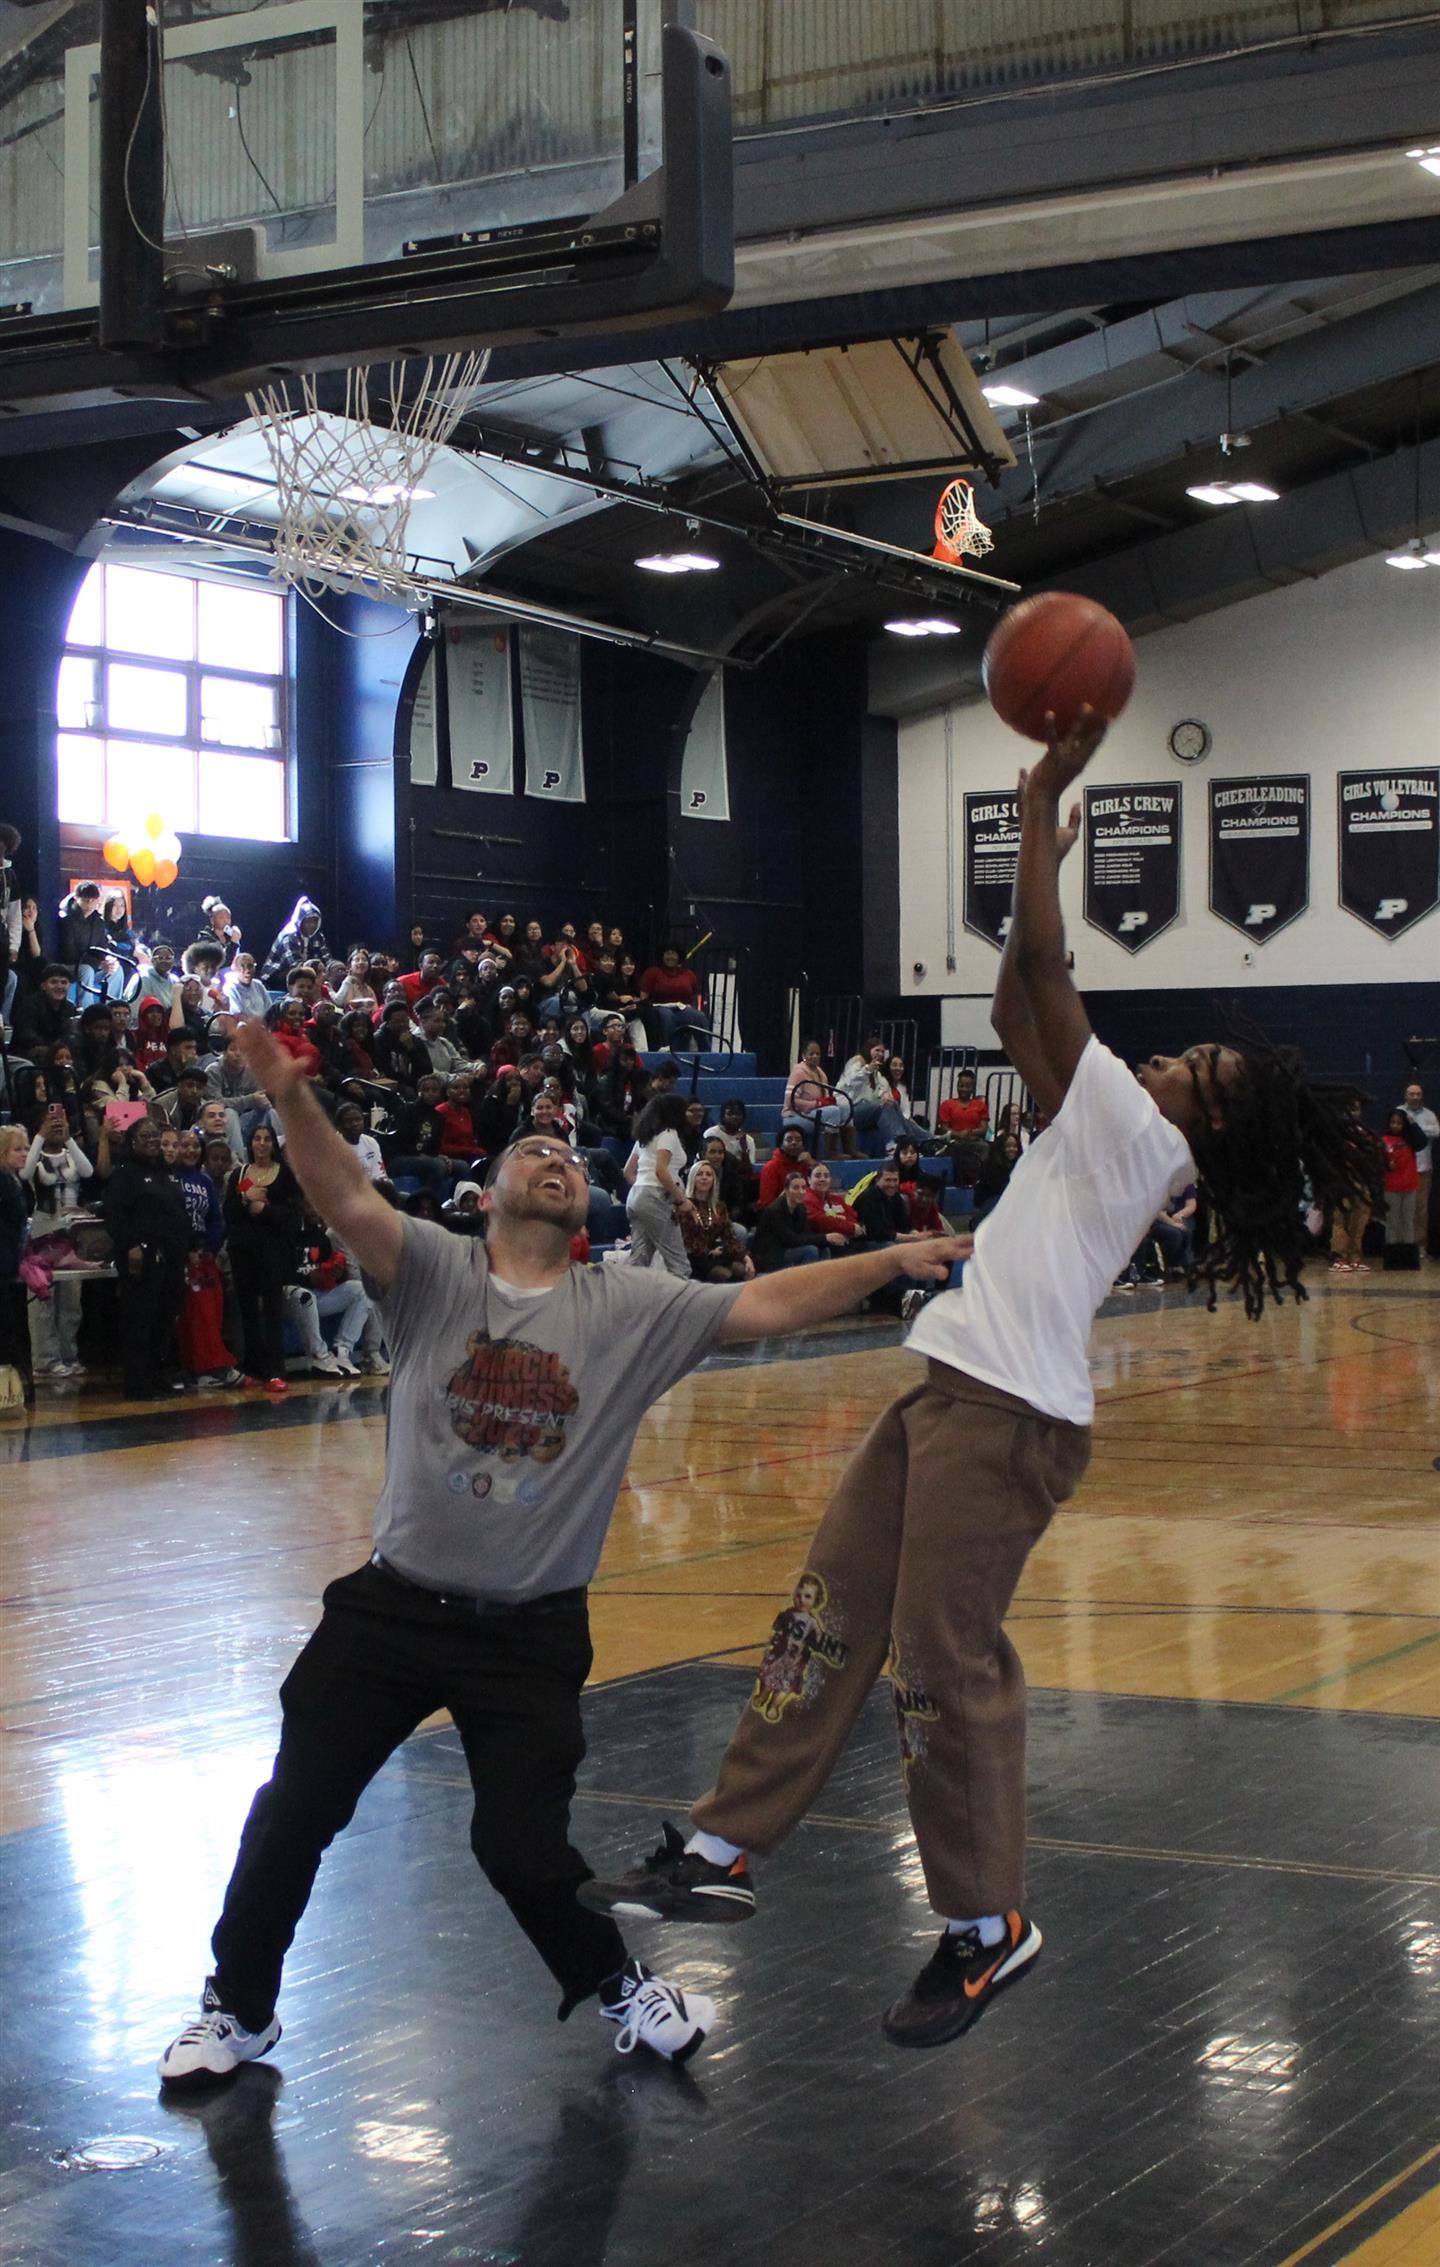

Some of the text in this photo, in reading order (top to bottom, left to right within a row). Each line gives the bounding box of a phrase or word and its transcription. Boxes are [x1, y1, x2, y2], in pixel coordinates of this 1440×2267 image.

[470, 761, 488, 779] P
[543, 771, 560, 788] P
[690, 791, 706, 808] P
[1215, 787, 1305, 808] CHEERLEADING
[1343, 780, 1437, 802] GIRLS VOLLEYBALL
[971, 803, 1010, 823] GIRLS
[1091, 796, 1174, 816] GIRLS CREW
[1221, 816, 1298, 828] CHAMPIONS
[1350, 809, 1430, 822] CHAMPIONS
[1095, 825, 1170, 836] CHAMPIONS
